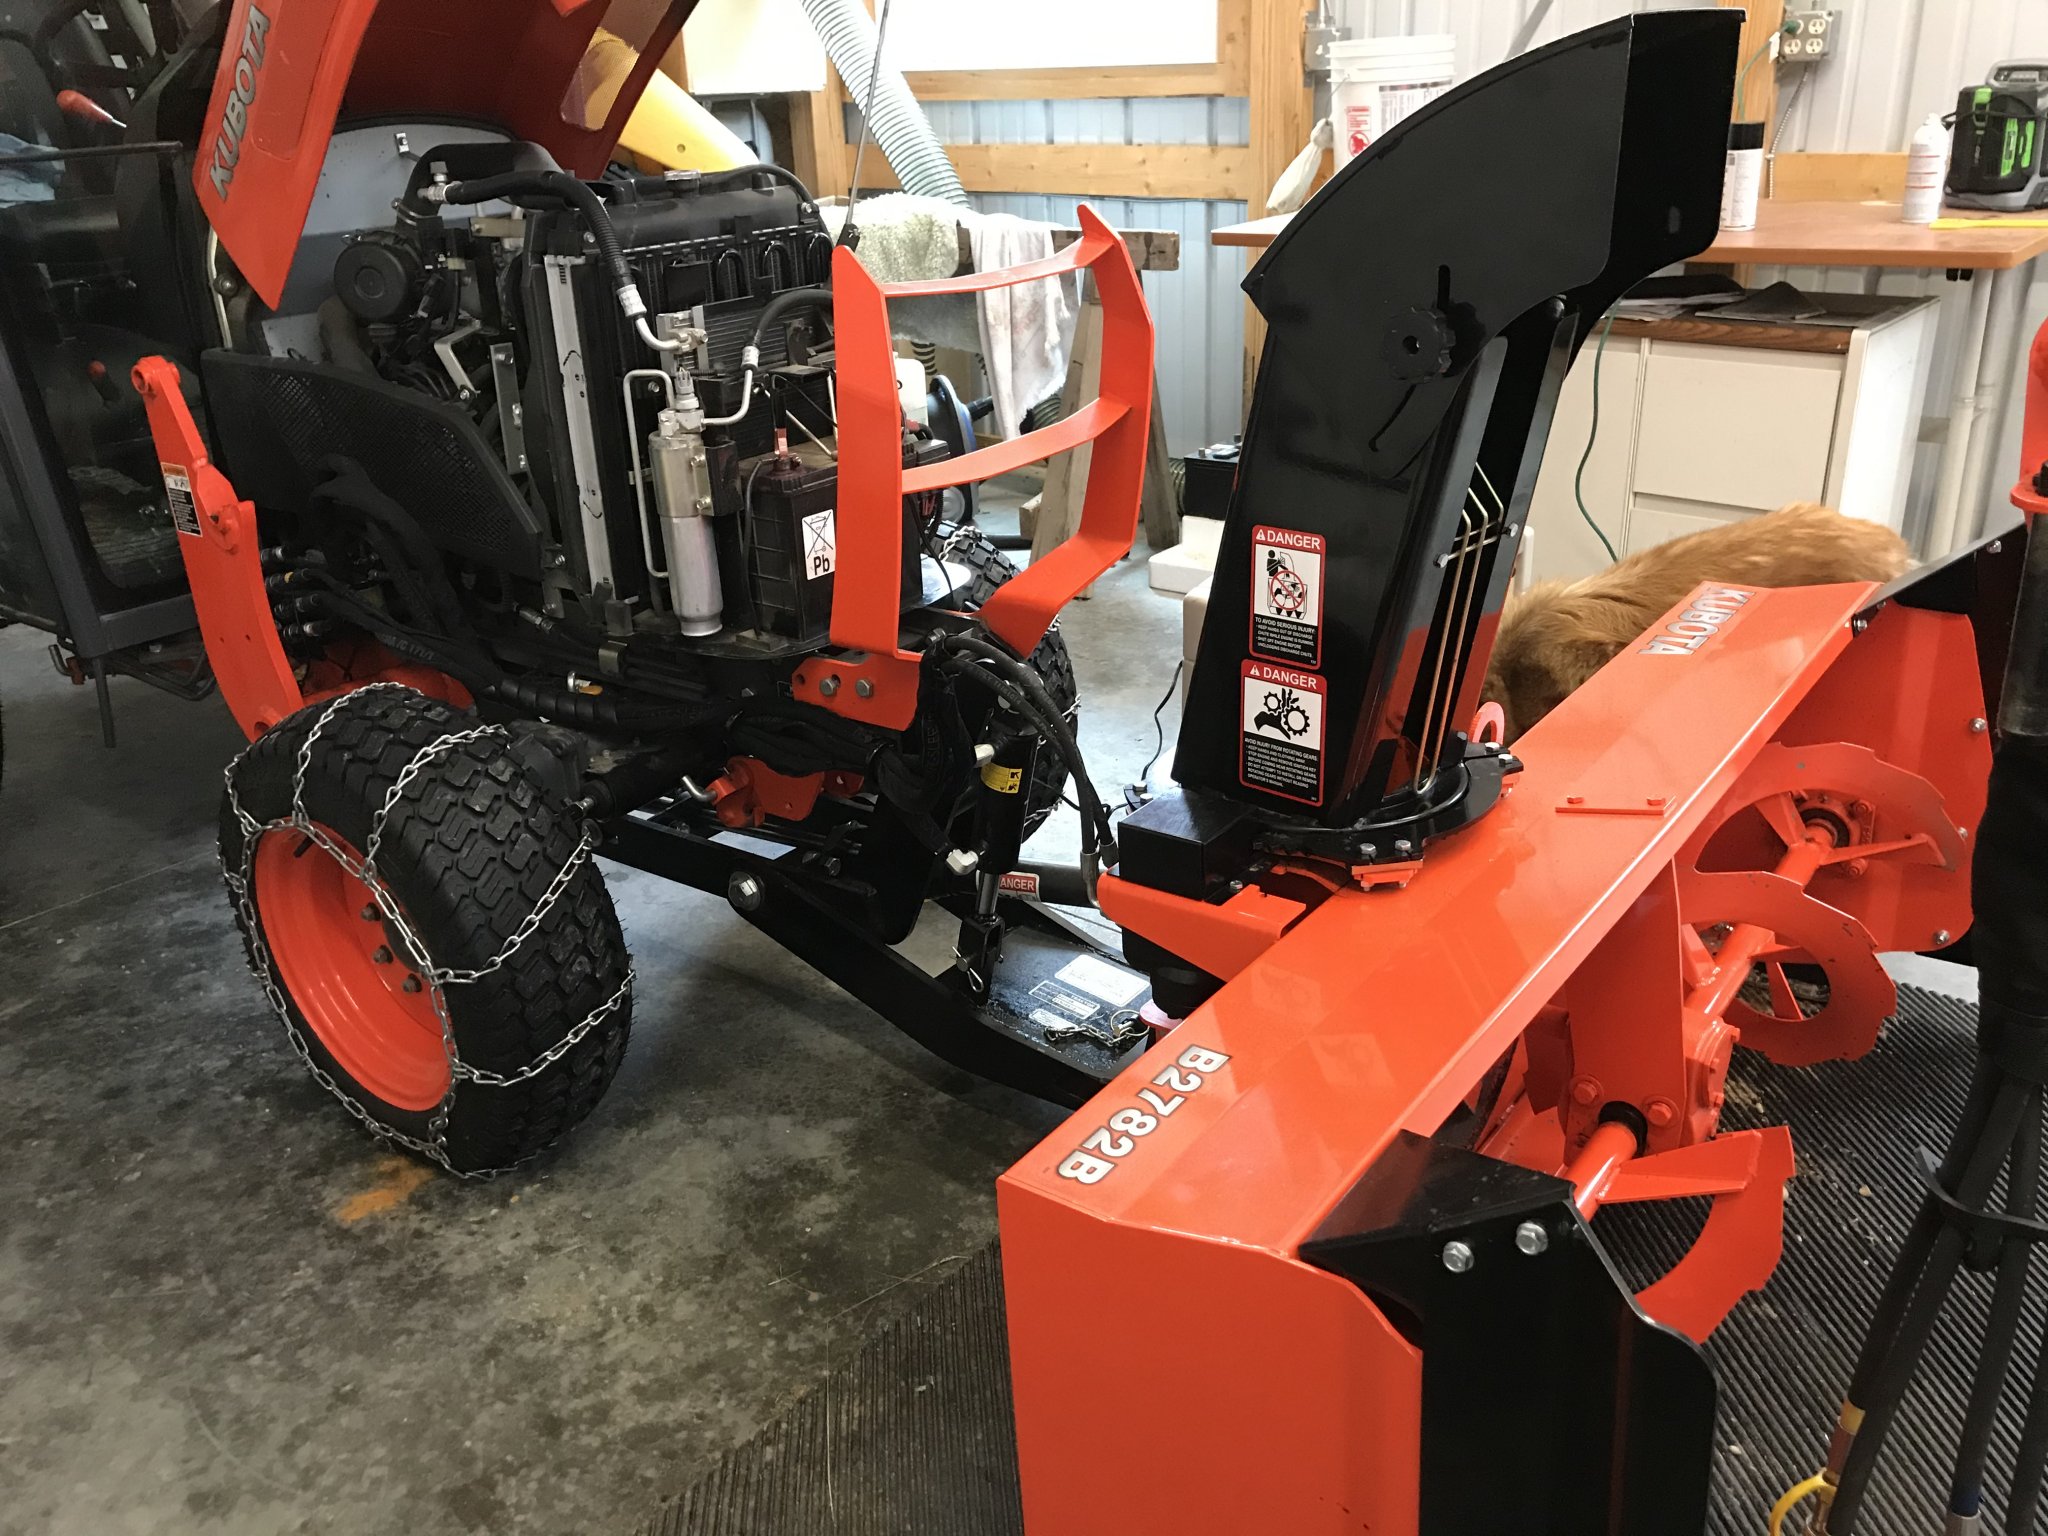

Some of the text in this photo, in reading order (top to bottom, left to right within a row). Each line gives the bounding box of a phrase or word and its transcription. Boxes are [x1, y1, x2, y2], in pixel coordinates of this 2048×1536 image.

[210, 5, 271, 200] KUBOTA
[1267, 530, 1320, 550] DANGER
[814, 554, 830, 576] Pb
[1277, 622, 1297, 630] SERIOUS
[1636, 588, 1756, 655] KUBOTA
[1263, 667, 1317, 689] DANGER
[1283, 748, 1302, 757] ROTATING
[1286, 767, 1303, 775] ROTATING
[1000, 878, 1034, 890] ANGER
[1056, 1044, 1232, 1184] B2782B
